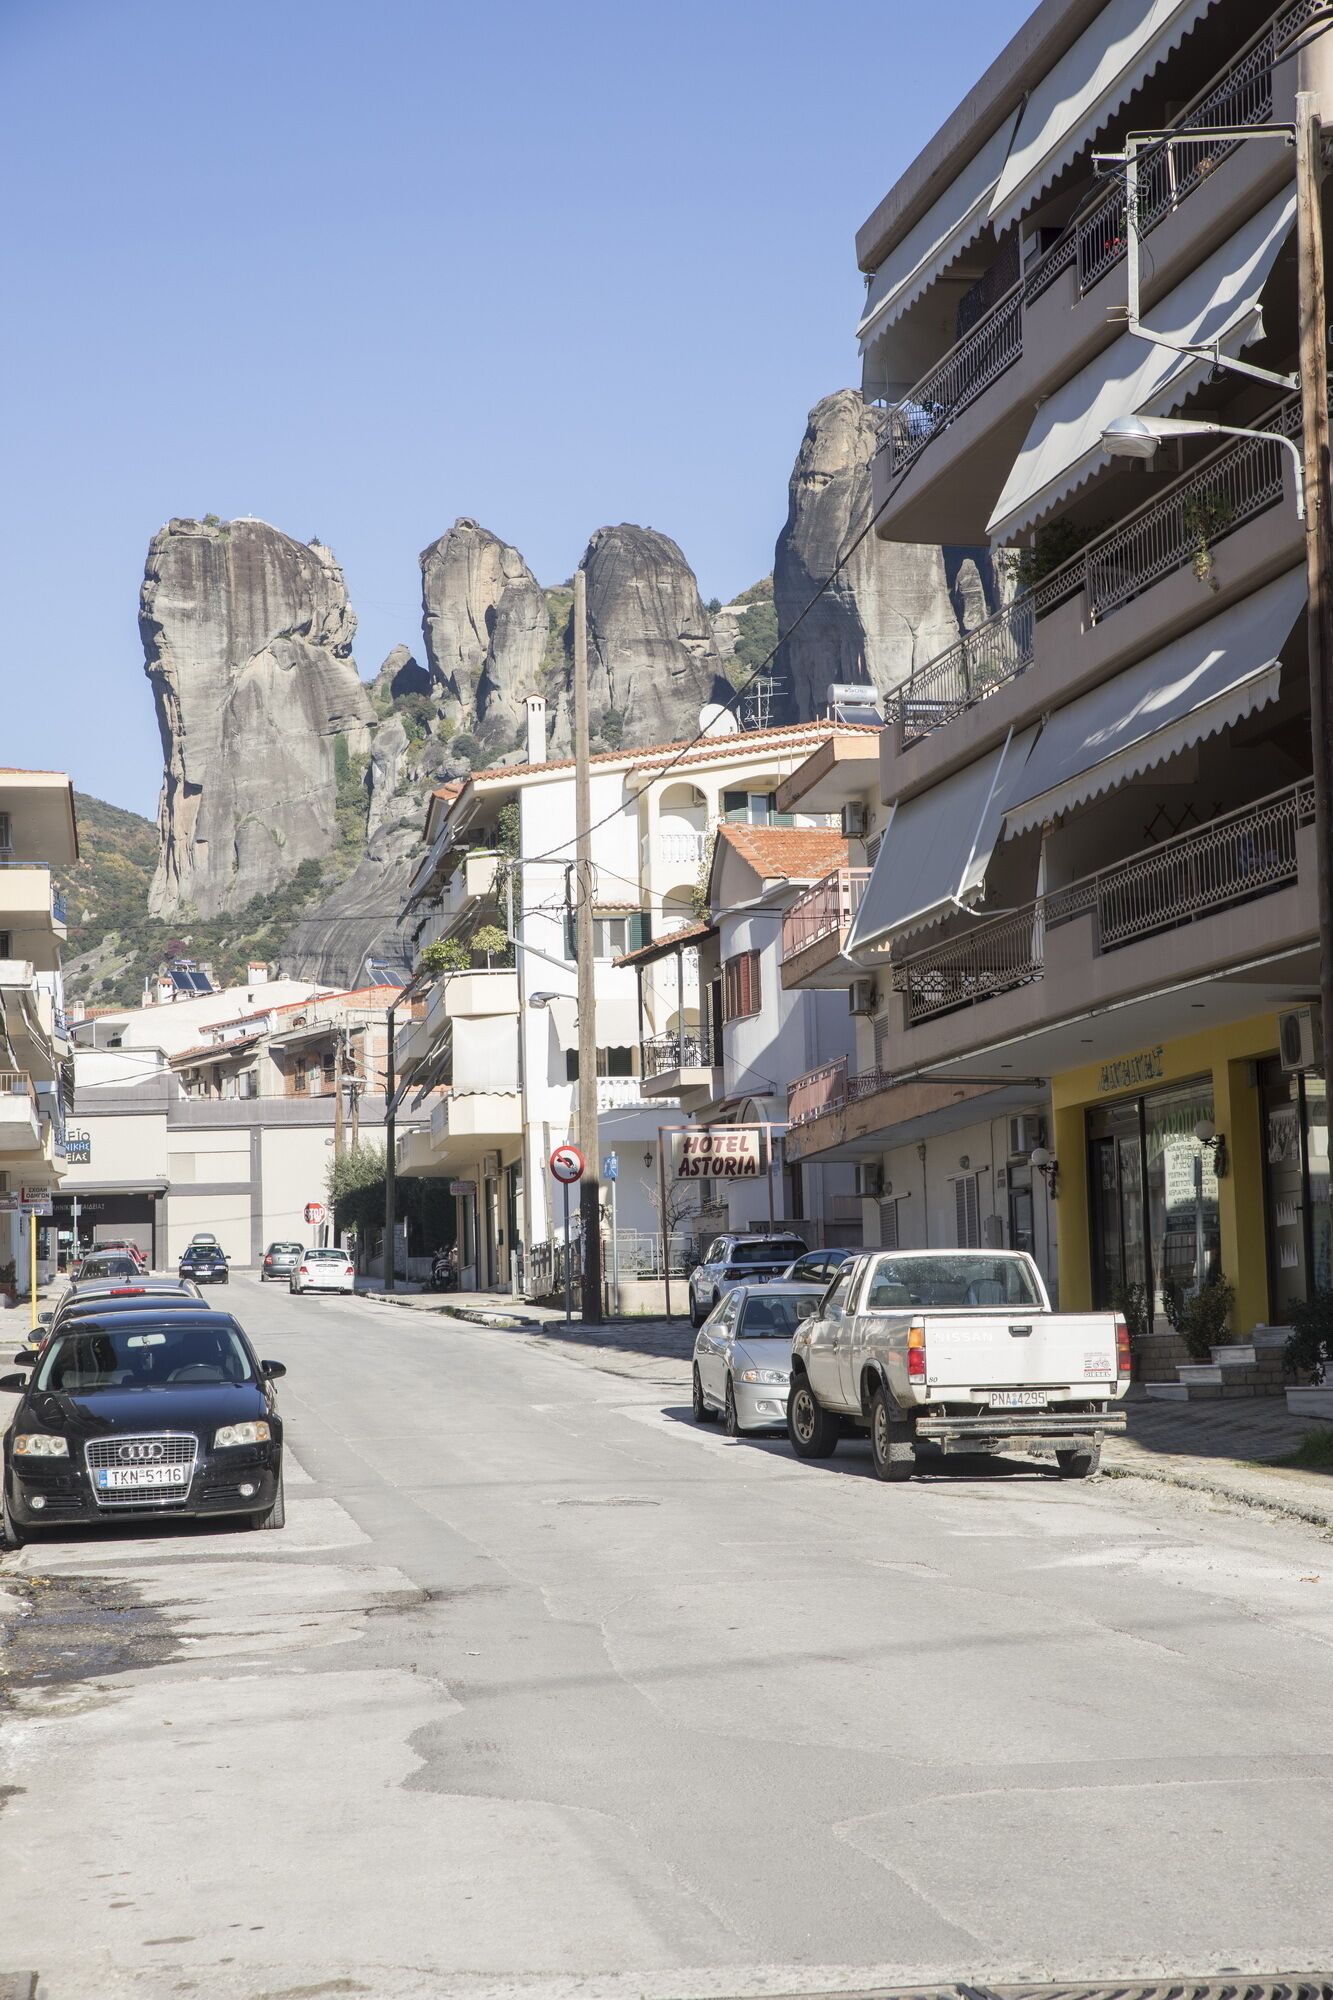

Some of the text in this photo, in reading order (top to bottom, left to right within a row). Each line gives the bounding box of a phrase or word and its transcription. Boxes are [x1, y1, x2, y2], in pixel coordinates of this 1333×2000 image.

[683, 1136, 749, 1153] HOTEL
[679, 1156, 755, 1176] ASTORIA
[304, 1208, 325, 1220] STOP
[935, 1331, 993, 1343] NISSAN
[1017, 1392, 1046, 1405] 4295
